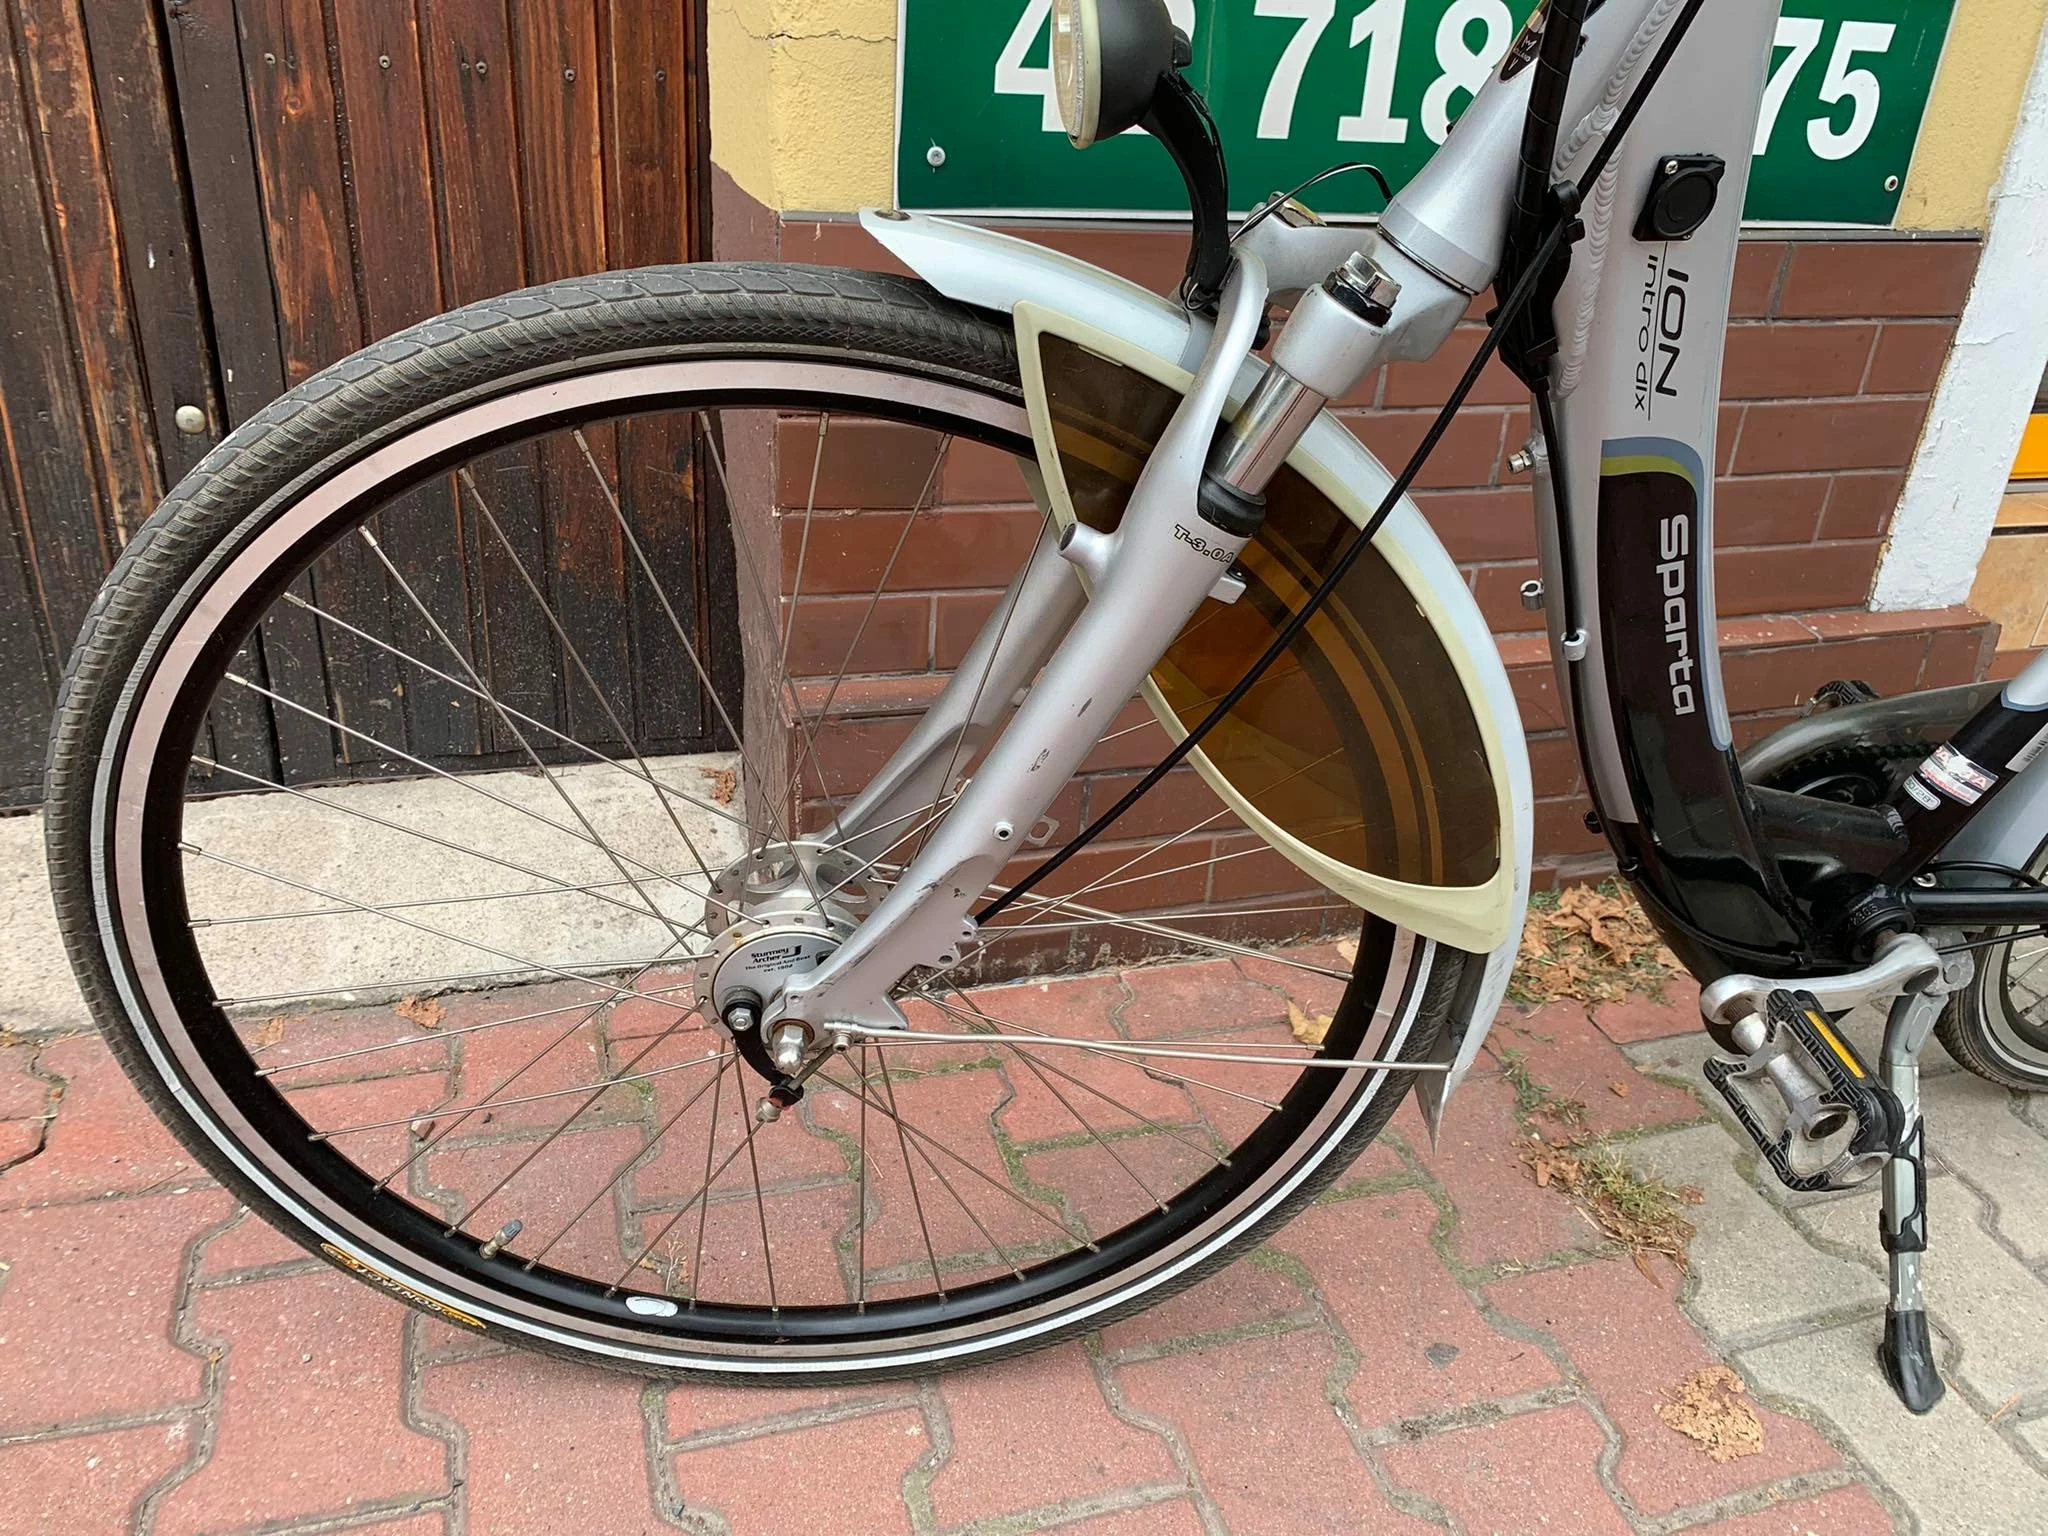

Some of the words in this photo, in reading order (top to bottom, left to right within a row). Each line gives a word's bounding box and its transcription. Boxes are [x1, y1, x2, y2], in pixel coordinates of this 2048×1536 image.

[1253, 0, 1513, 146] 718
[1752, 16, 1897, 160] 75
[1638, 254, 1658, 352] intro
[1655, 268, 1689, 397] ION
[1174, 523, 1235, 564] T-3.0A
[1656, 514, 1696, 716] Sparta
[751, 947, 789, 958] Sturmey
[753, 955, 782, 963] Archer
